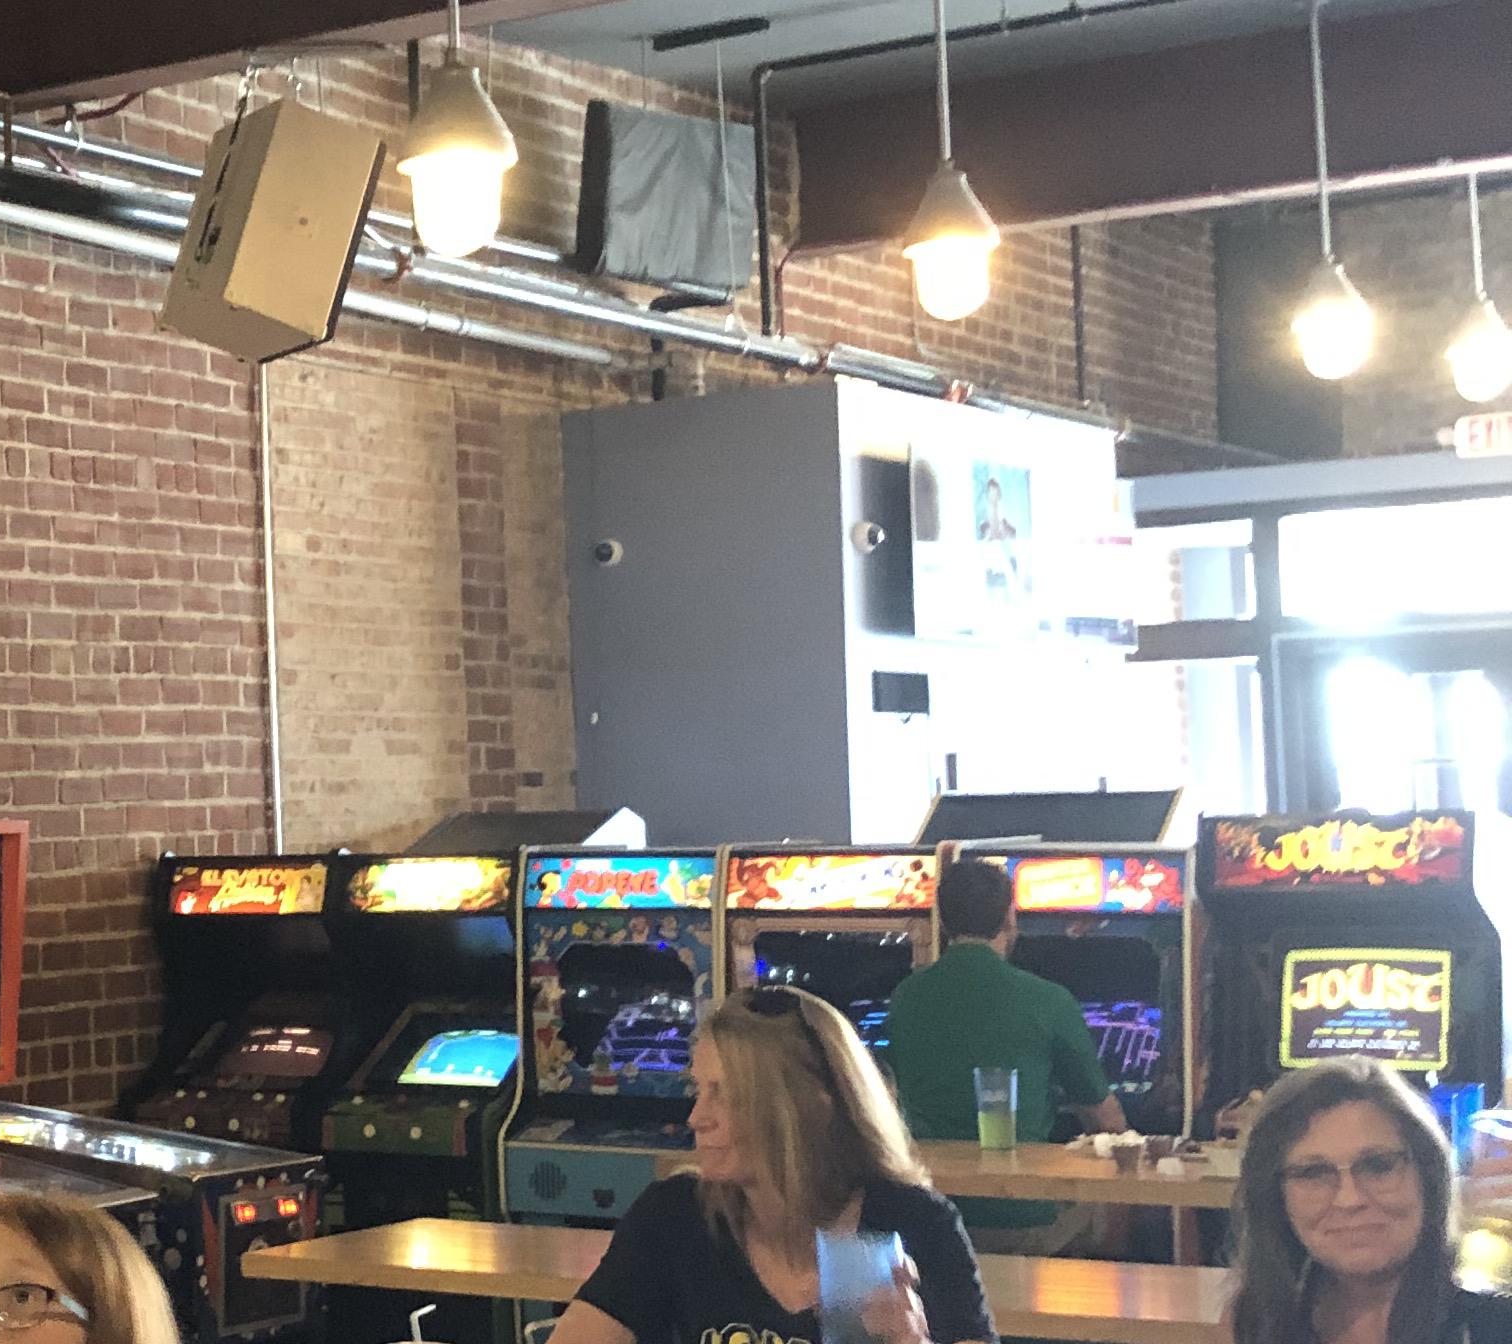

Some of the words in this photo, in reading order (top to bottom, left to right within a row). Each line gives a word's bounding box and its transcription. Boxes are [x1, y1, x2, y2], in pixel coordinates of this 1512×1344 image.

[1468, 417, 1512, 451] EXI
[565, 870, 660, 897] POPEYE
[1290, 962, 1443, 1012] JOUST
